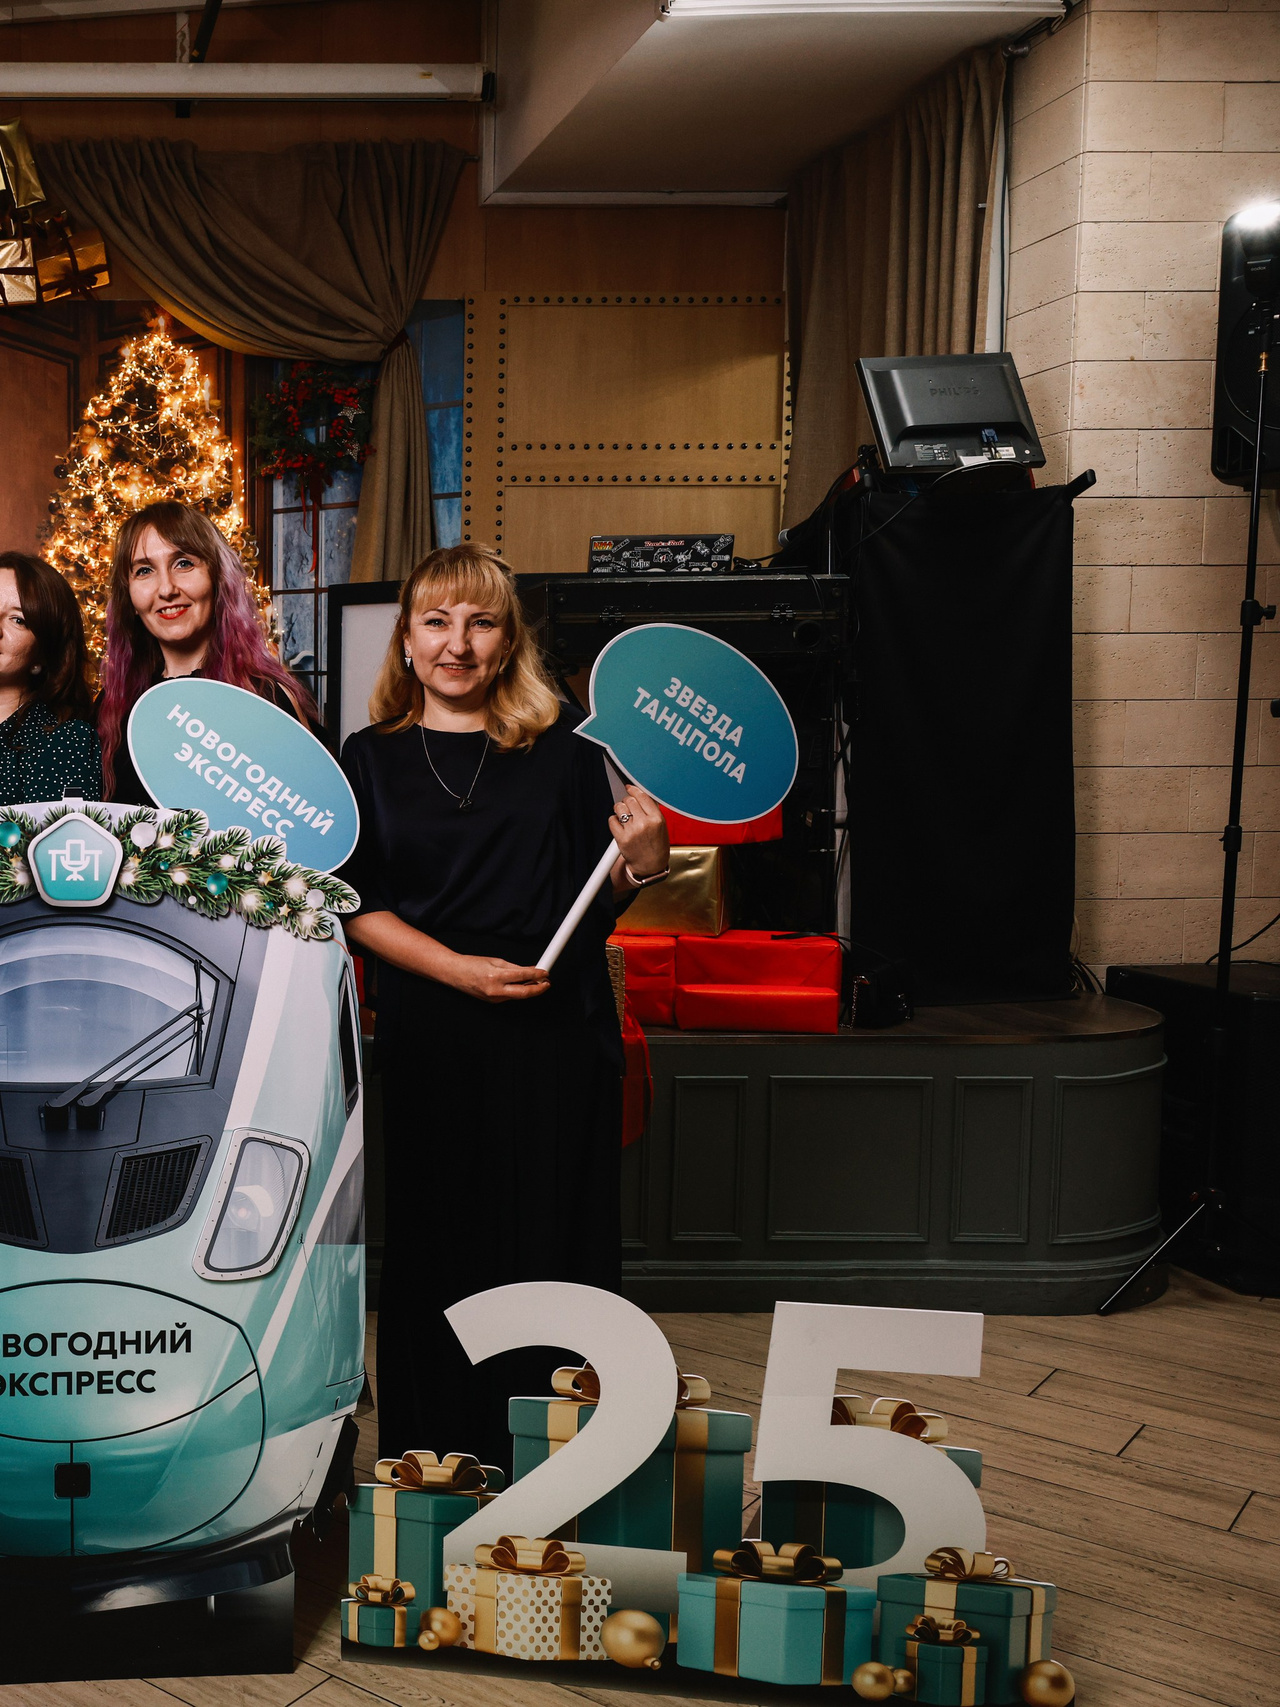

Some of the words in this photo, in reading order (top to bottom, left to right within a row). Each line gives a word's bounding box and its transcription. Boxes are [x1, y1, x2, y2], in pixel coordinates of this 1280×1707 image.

[633, 686, 747, 785] ТАНЦПОЛА
[663, 676, 744, 748] ЗВЕЗДА
[166, 703, 335, 836] НОВОГОДНИЙ
[173, 742, 295, 839] ЭКСПРЕСС
